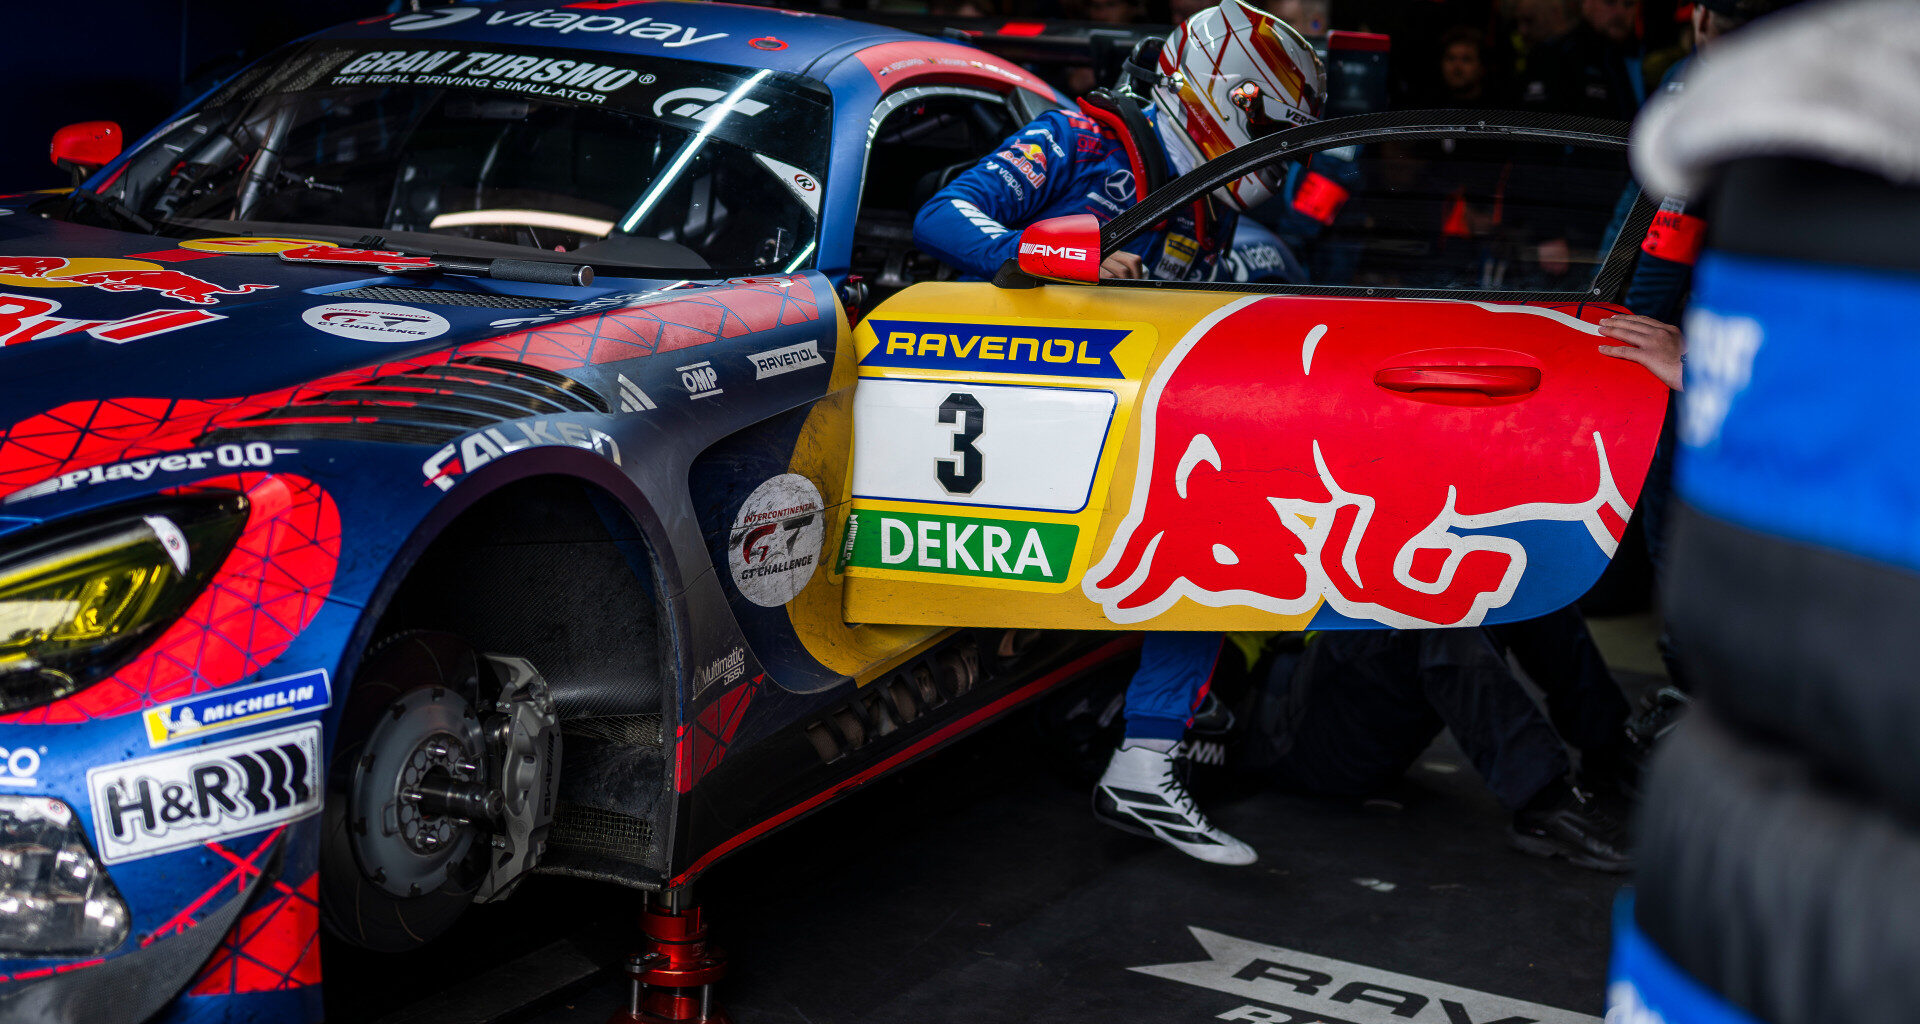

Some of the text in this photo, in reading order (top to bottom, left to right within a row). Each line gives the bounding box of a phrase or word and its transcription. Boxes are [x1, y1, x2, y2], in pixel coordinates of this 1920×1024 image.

[485, 8, 730, 48] viaplay
[340, 50, 639, 92] GRAN TURISMO
[331, 75, 608, 105] THE REAL DRIVING SIMULATOR
[999, 167, 1025, 201] viaplay
[1031, 243, 1087, 261] AMG
[325, 307, 433, 319] INTERCONTINENTAL
[340, 323, 428, 336] CHALLENGE
[757, 347, 818, 372] RAVENOL
[886, 331, 1102, 365] RAVENOL
[681, 366, 718, 393] OMP
[422, 420, 622, 492] FALKEN
[935, 391, 986, 497] 3
[58, 441, 273, 491] Player 0.0
[743, 501, 818, 524] INTERCONTINENTAL
[881, 517, 1053, 577] DEKRA
[741, 554, 813, 580] GT CHALLENGE
[702, 646, 744, 685] Multimatic
[203, 684, 314, 723] MICHELIN
[106, 765, 237, 838] H&R
